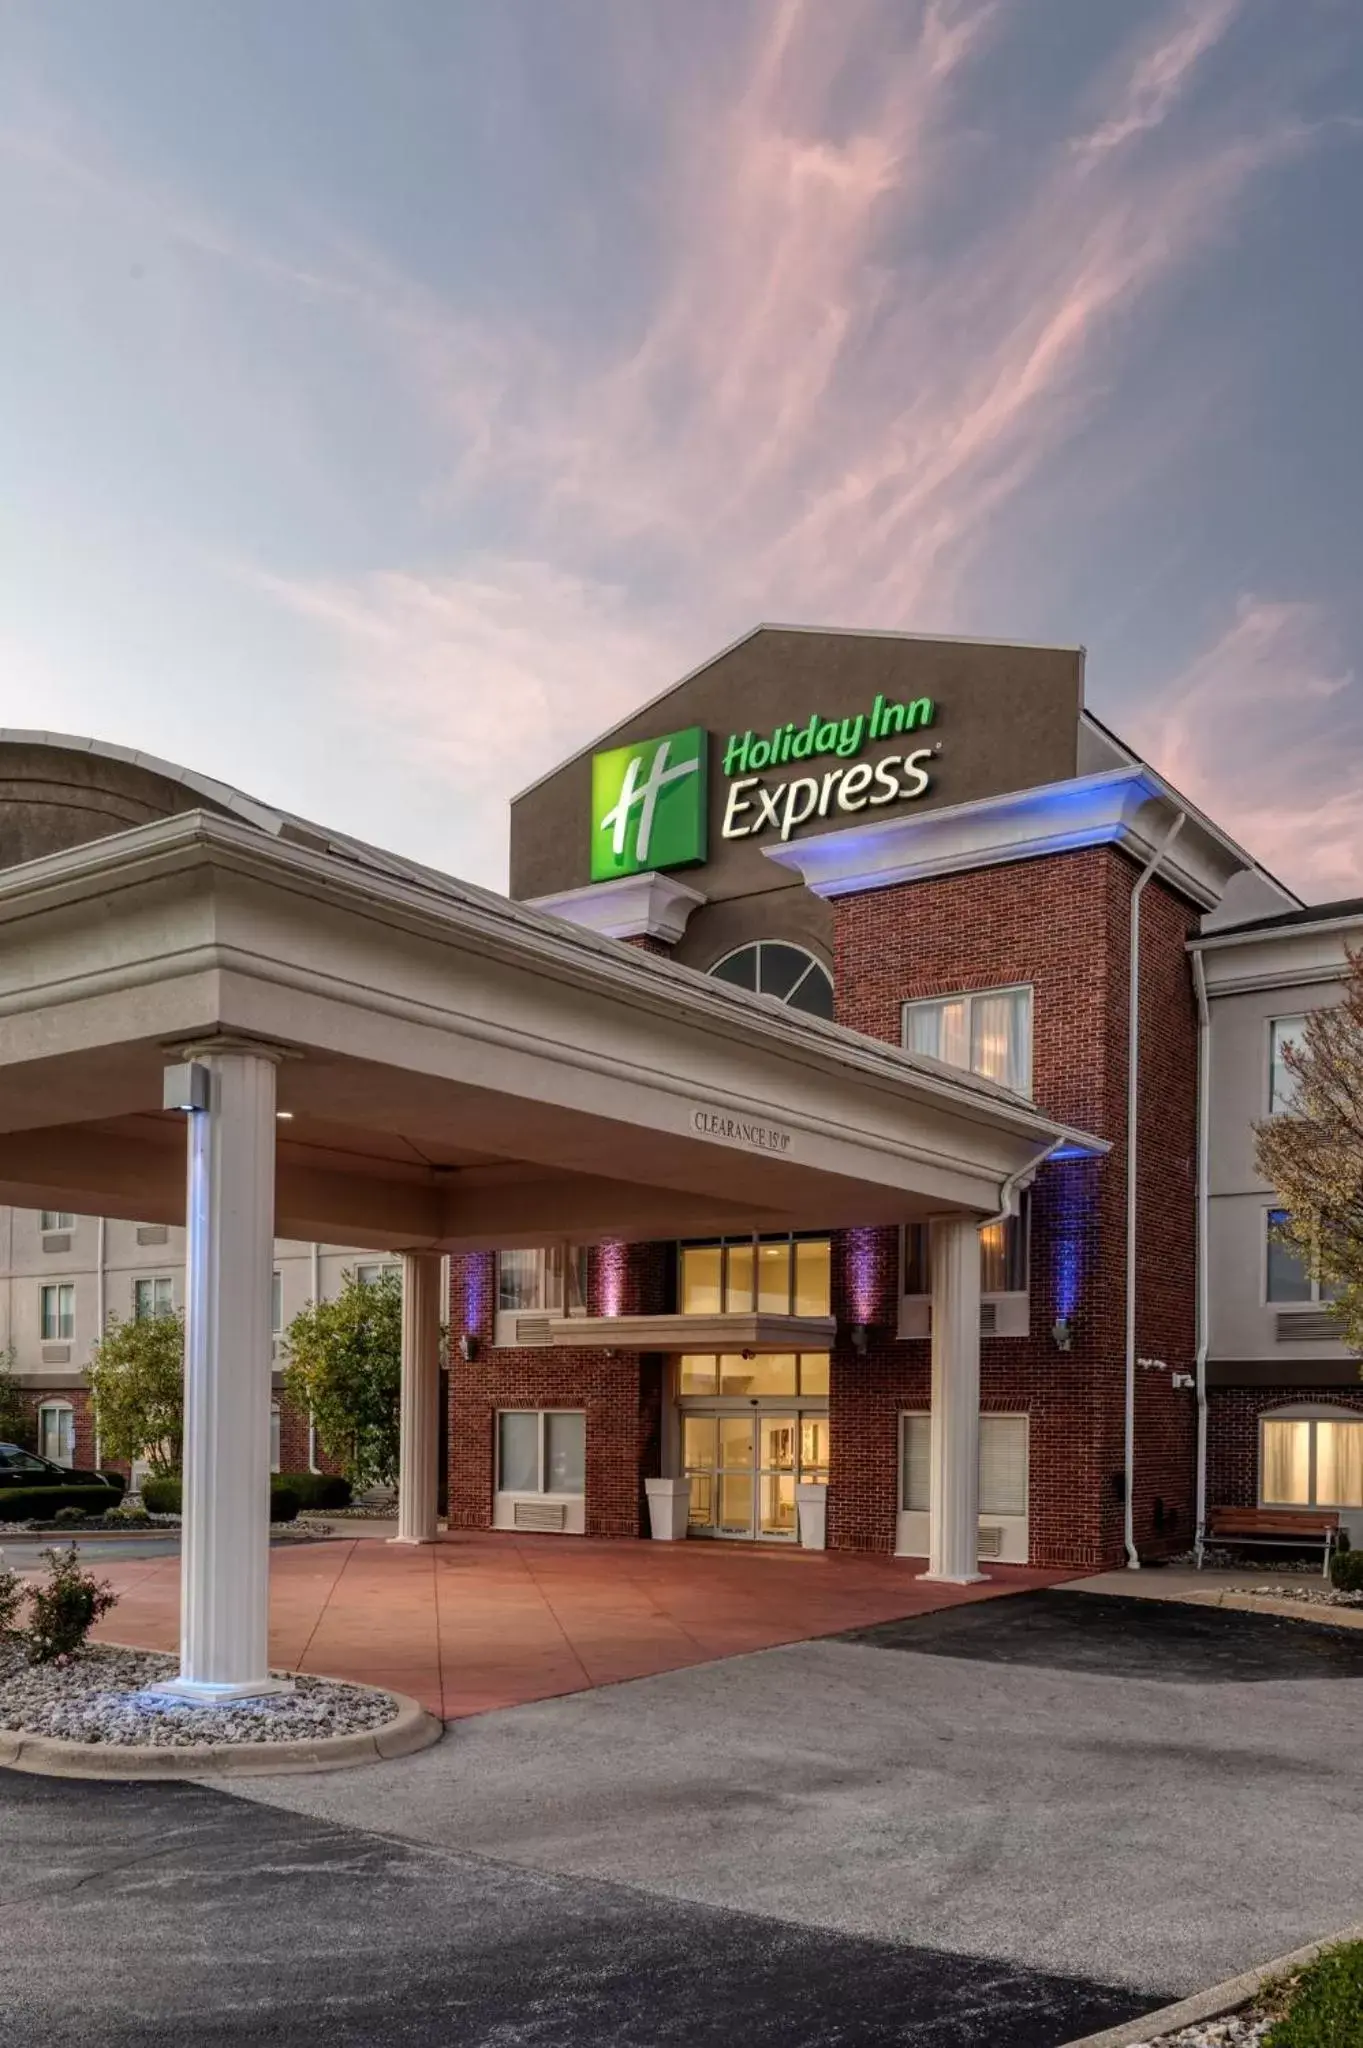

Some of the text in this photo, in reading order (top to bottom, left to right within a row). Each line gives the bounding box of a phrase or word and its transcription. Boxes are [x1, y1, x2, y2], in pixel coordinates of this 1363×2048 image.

[722, 692, 933, 776] Holiday Inn
[722, 748, 932, 841] Express
[694, 1112, 766, 1146] CLEARANCE
